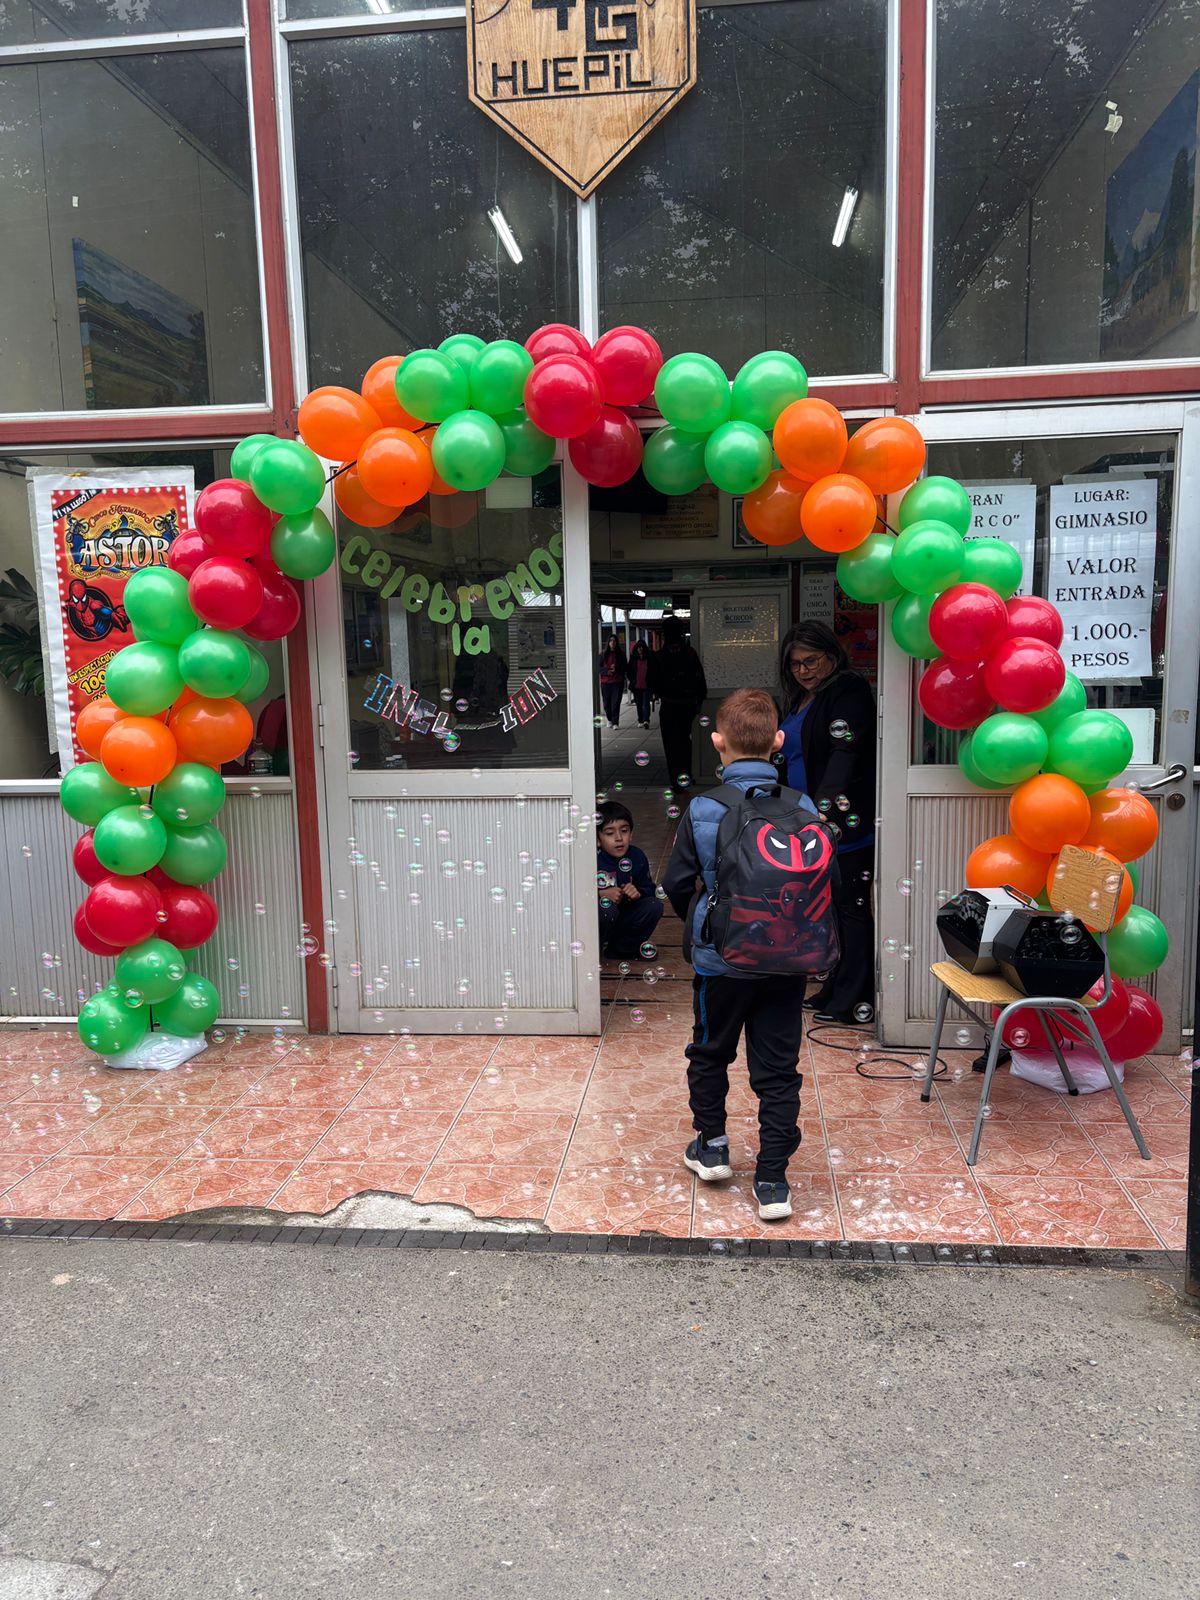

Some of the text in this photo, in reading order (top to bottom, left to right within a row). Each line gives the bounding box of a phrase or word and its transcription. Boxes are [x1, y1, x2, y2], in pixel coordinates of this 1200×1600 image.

[967, 493, 1004, 506] RAN
[1073, 488, 1131, 504] LUGAR:
[1055, 510, 1148, 530] GIMNASIO
[1066, 557, 1138, 576] VALOR
[1056, 585, 1147, 602] ENTRADA
[451, 622, 491, 657] la
[1071, 622, 1148, 642] 1.000.-
[1071, 651, 1131, 668] PESOS
